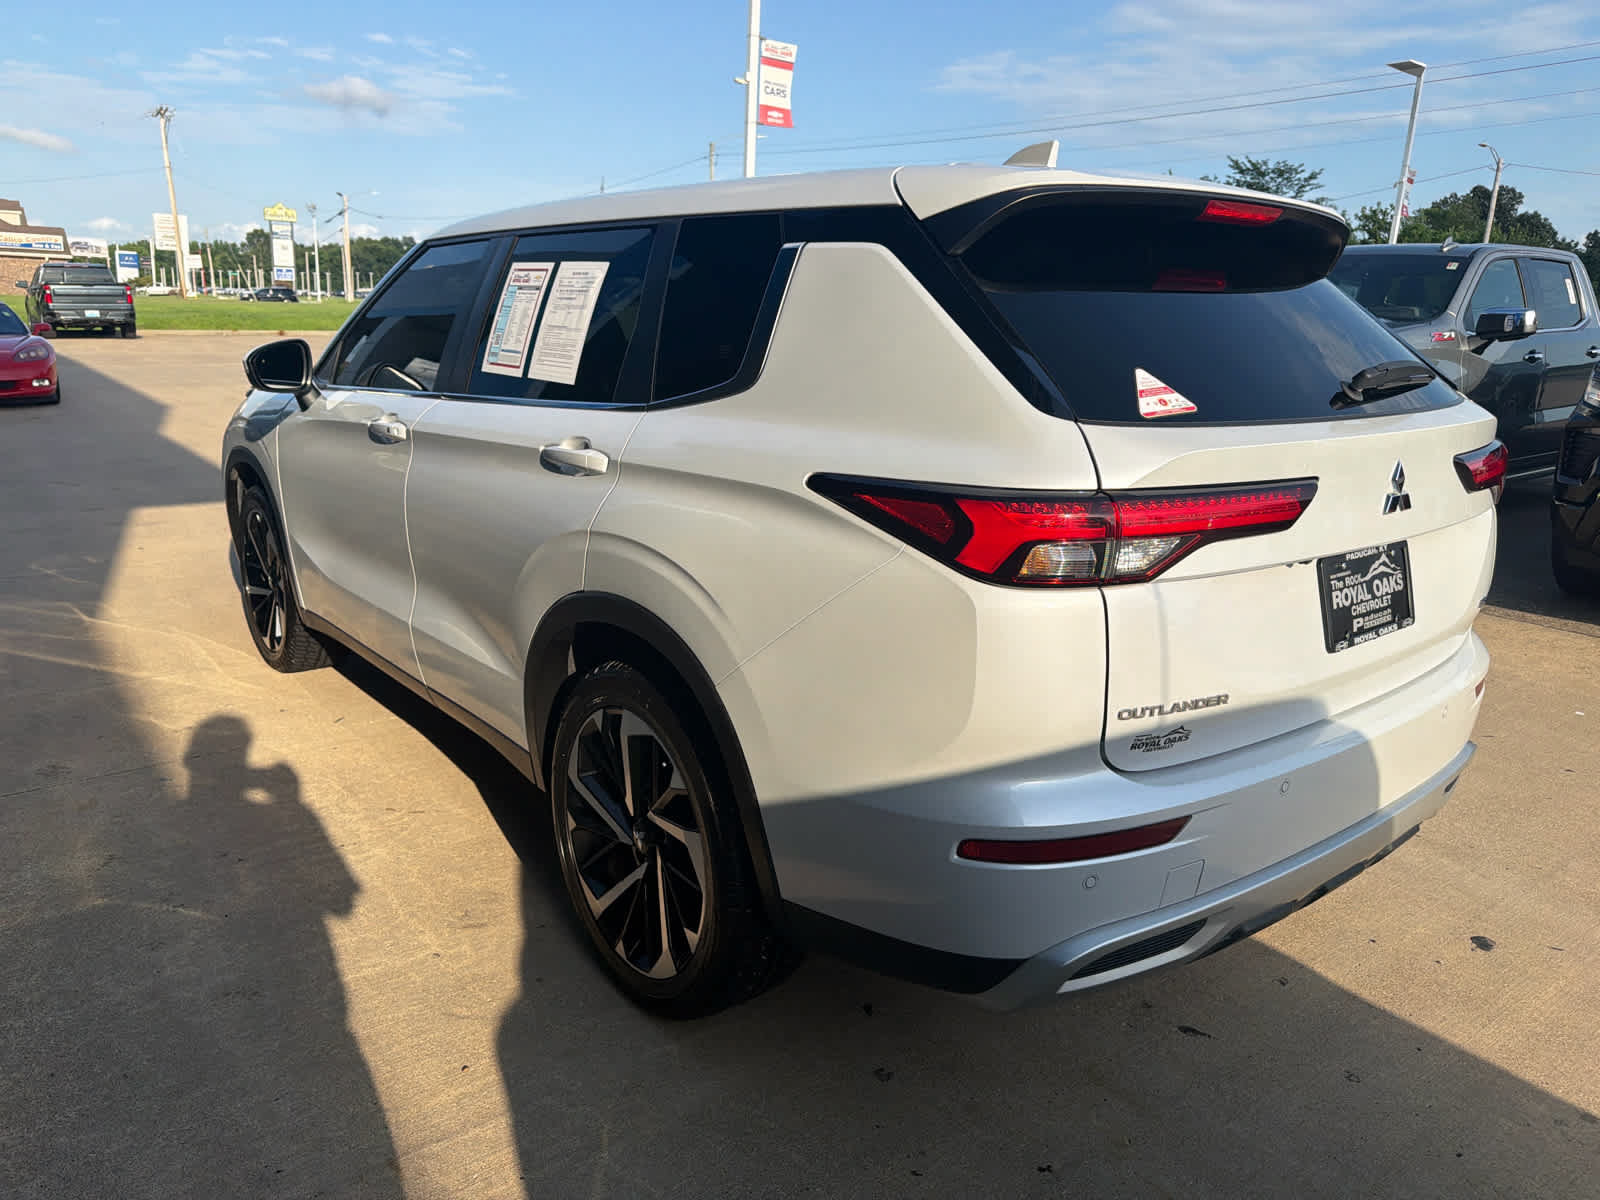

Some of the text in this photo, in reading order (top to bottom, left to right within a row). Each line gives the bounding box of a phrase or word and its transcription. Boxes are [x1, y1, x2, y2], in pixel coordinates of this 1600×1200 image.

[764, 85, 787, 98] CARS
[1432, 331, 1455, 342] Z71
[1330, 580, 1344, 591] The
[1332, 573, 1404, 609] ROYAL OAKS
[1351, 595, 1392, 616] CHEVROLET
[1354, 623, 1398, 645] ROYAL OAKS
[1117, 693, 1230, 721] OUTLANDER
[1130, 735, 1190, 751] ROYAL OAKS
